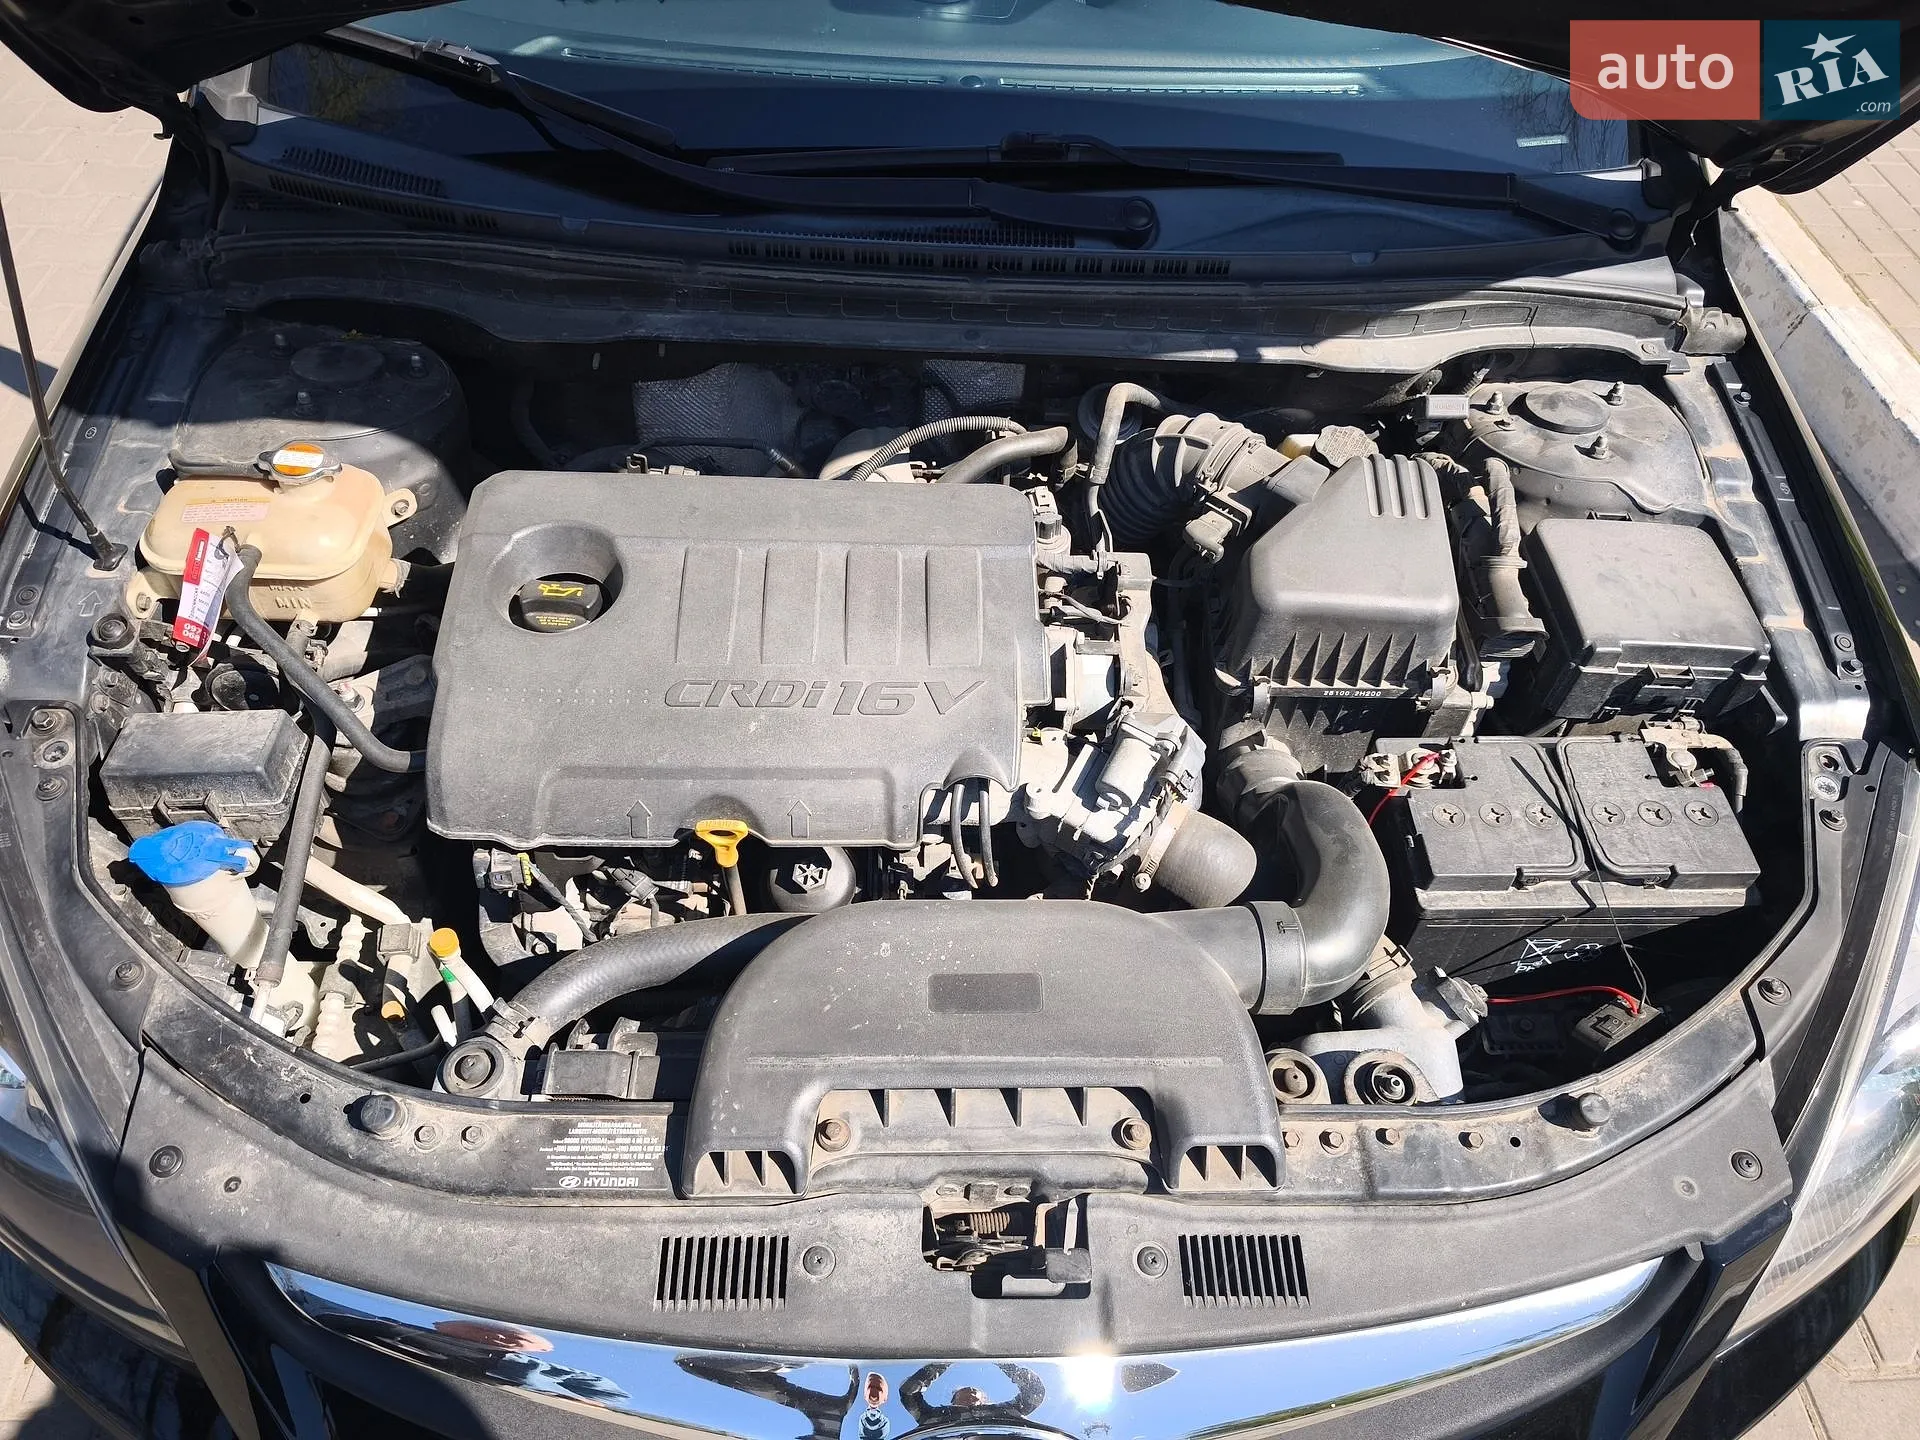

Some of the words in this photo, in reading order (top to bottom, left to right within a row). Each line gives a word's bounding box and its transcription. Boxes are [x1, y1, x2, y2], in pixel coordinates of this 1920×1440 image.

[664, 679, 829, 708] CRDi
[832, 680, 986, 716] 16V
[583, 1177, 639, 1188] HYUNDAI
